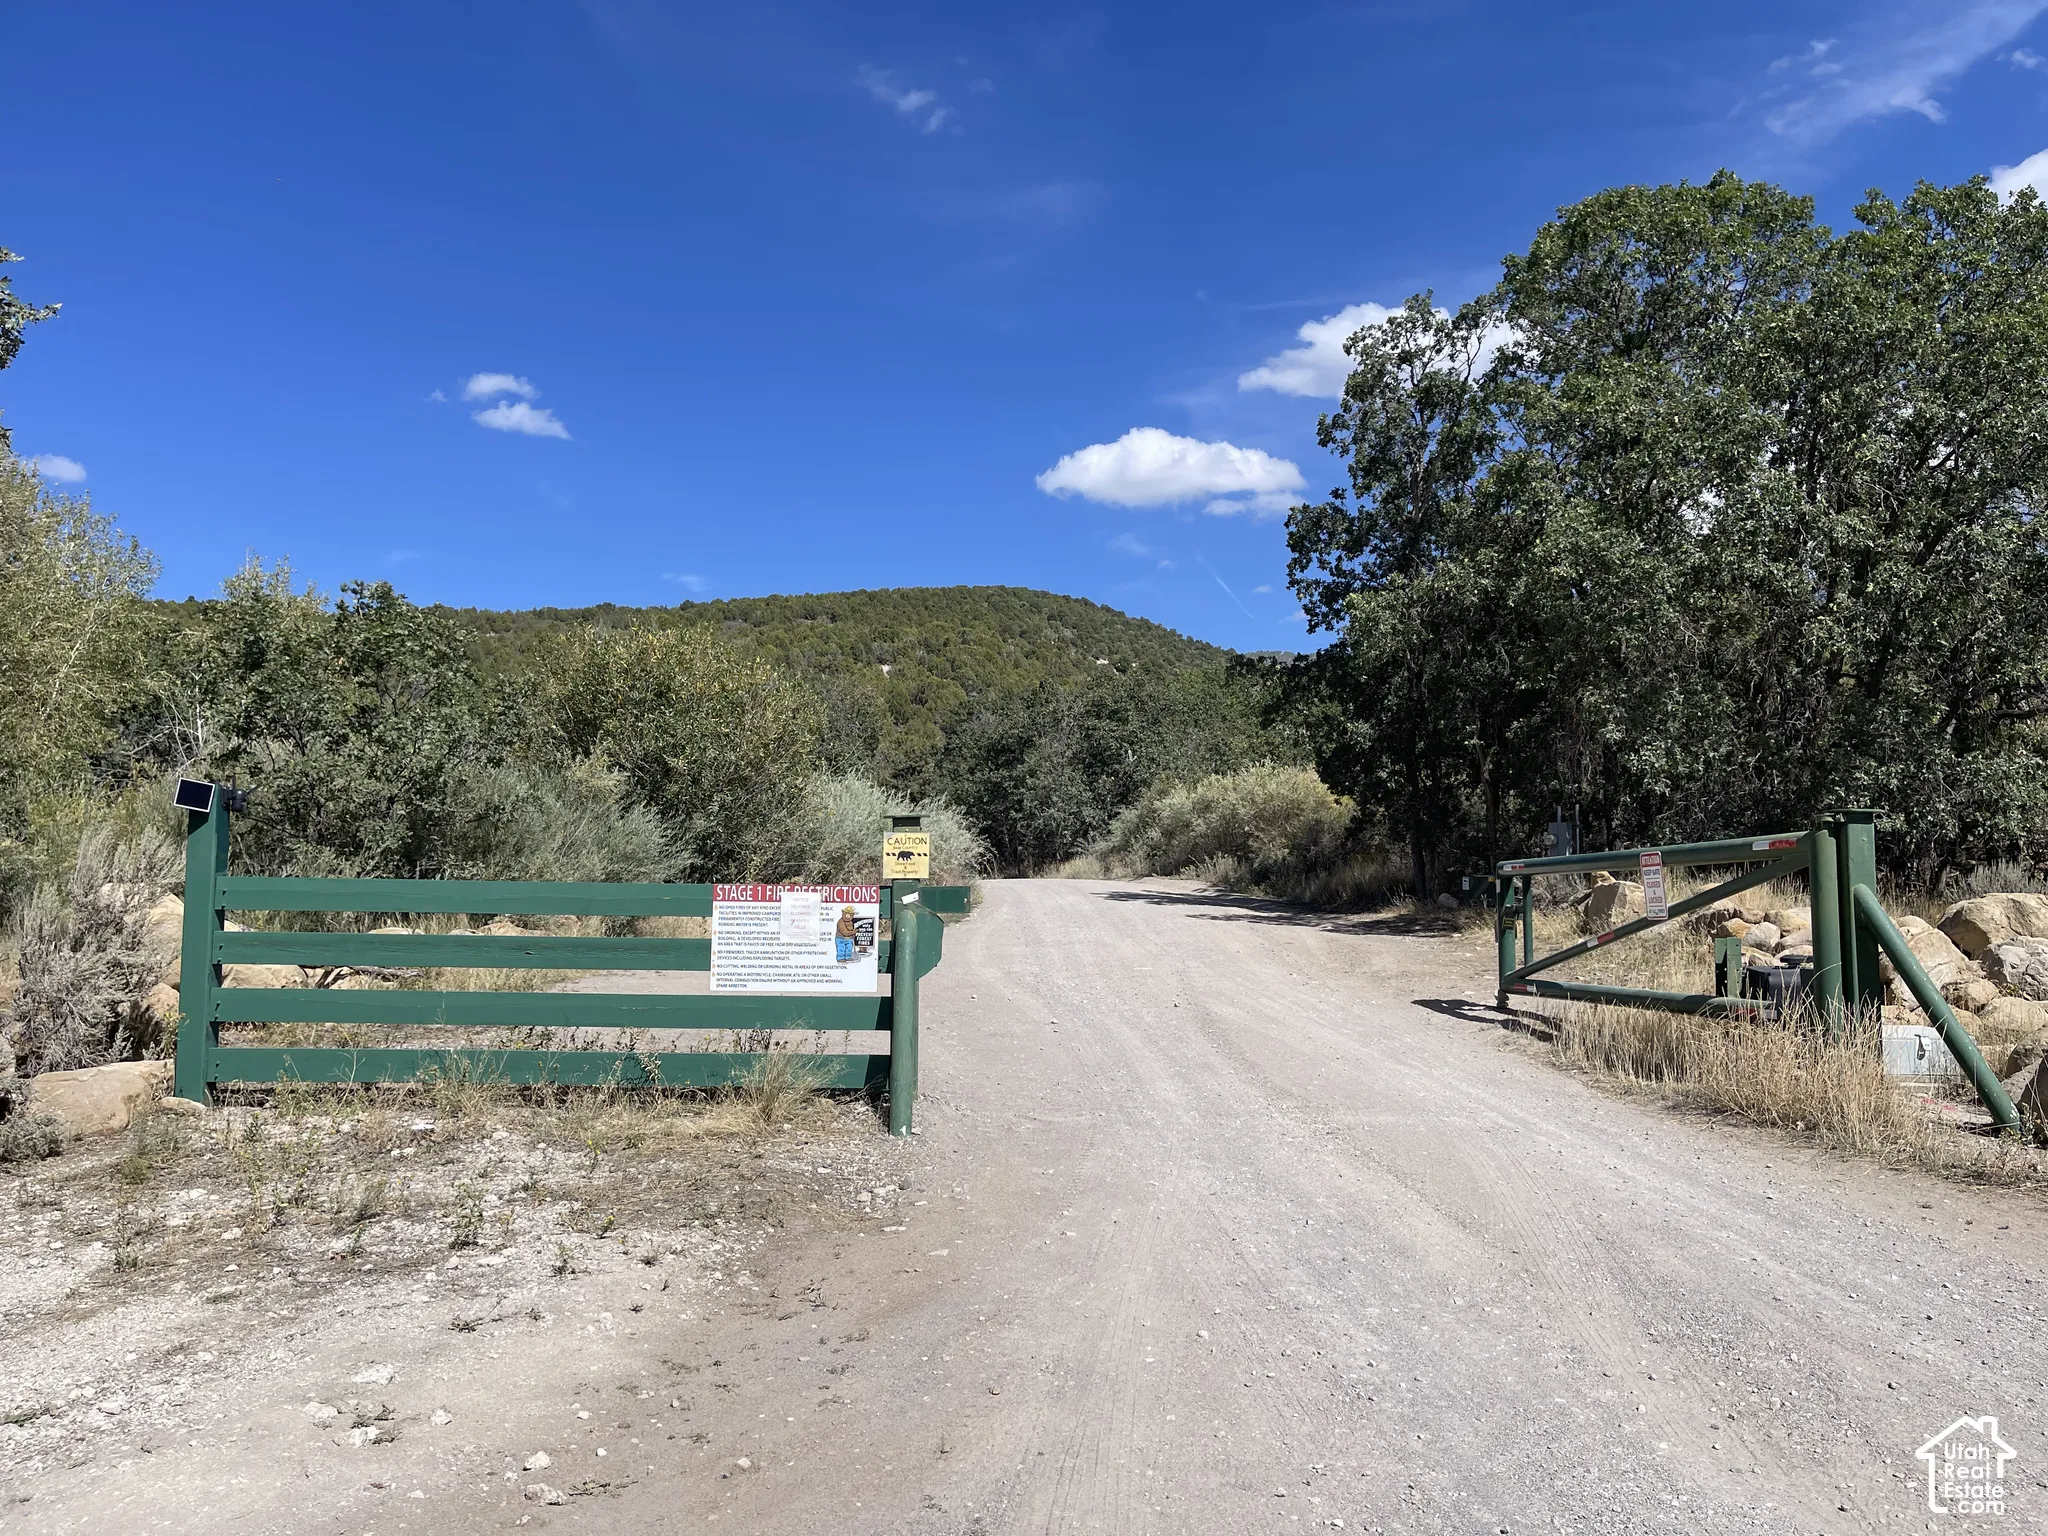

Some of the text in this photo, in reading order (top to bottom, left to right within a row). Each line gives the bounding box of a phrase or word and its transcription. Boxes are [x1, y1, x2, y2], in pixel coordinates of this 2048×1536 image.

[887, 837, 928, 845] CAUTION
[716, 884, 754, 901] STAGE
[757, 885, 762, 901] 1
